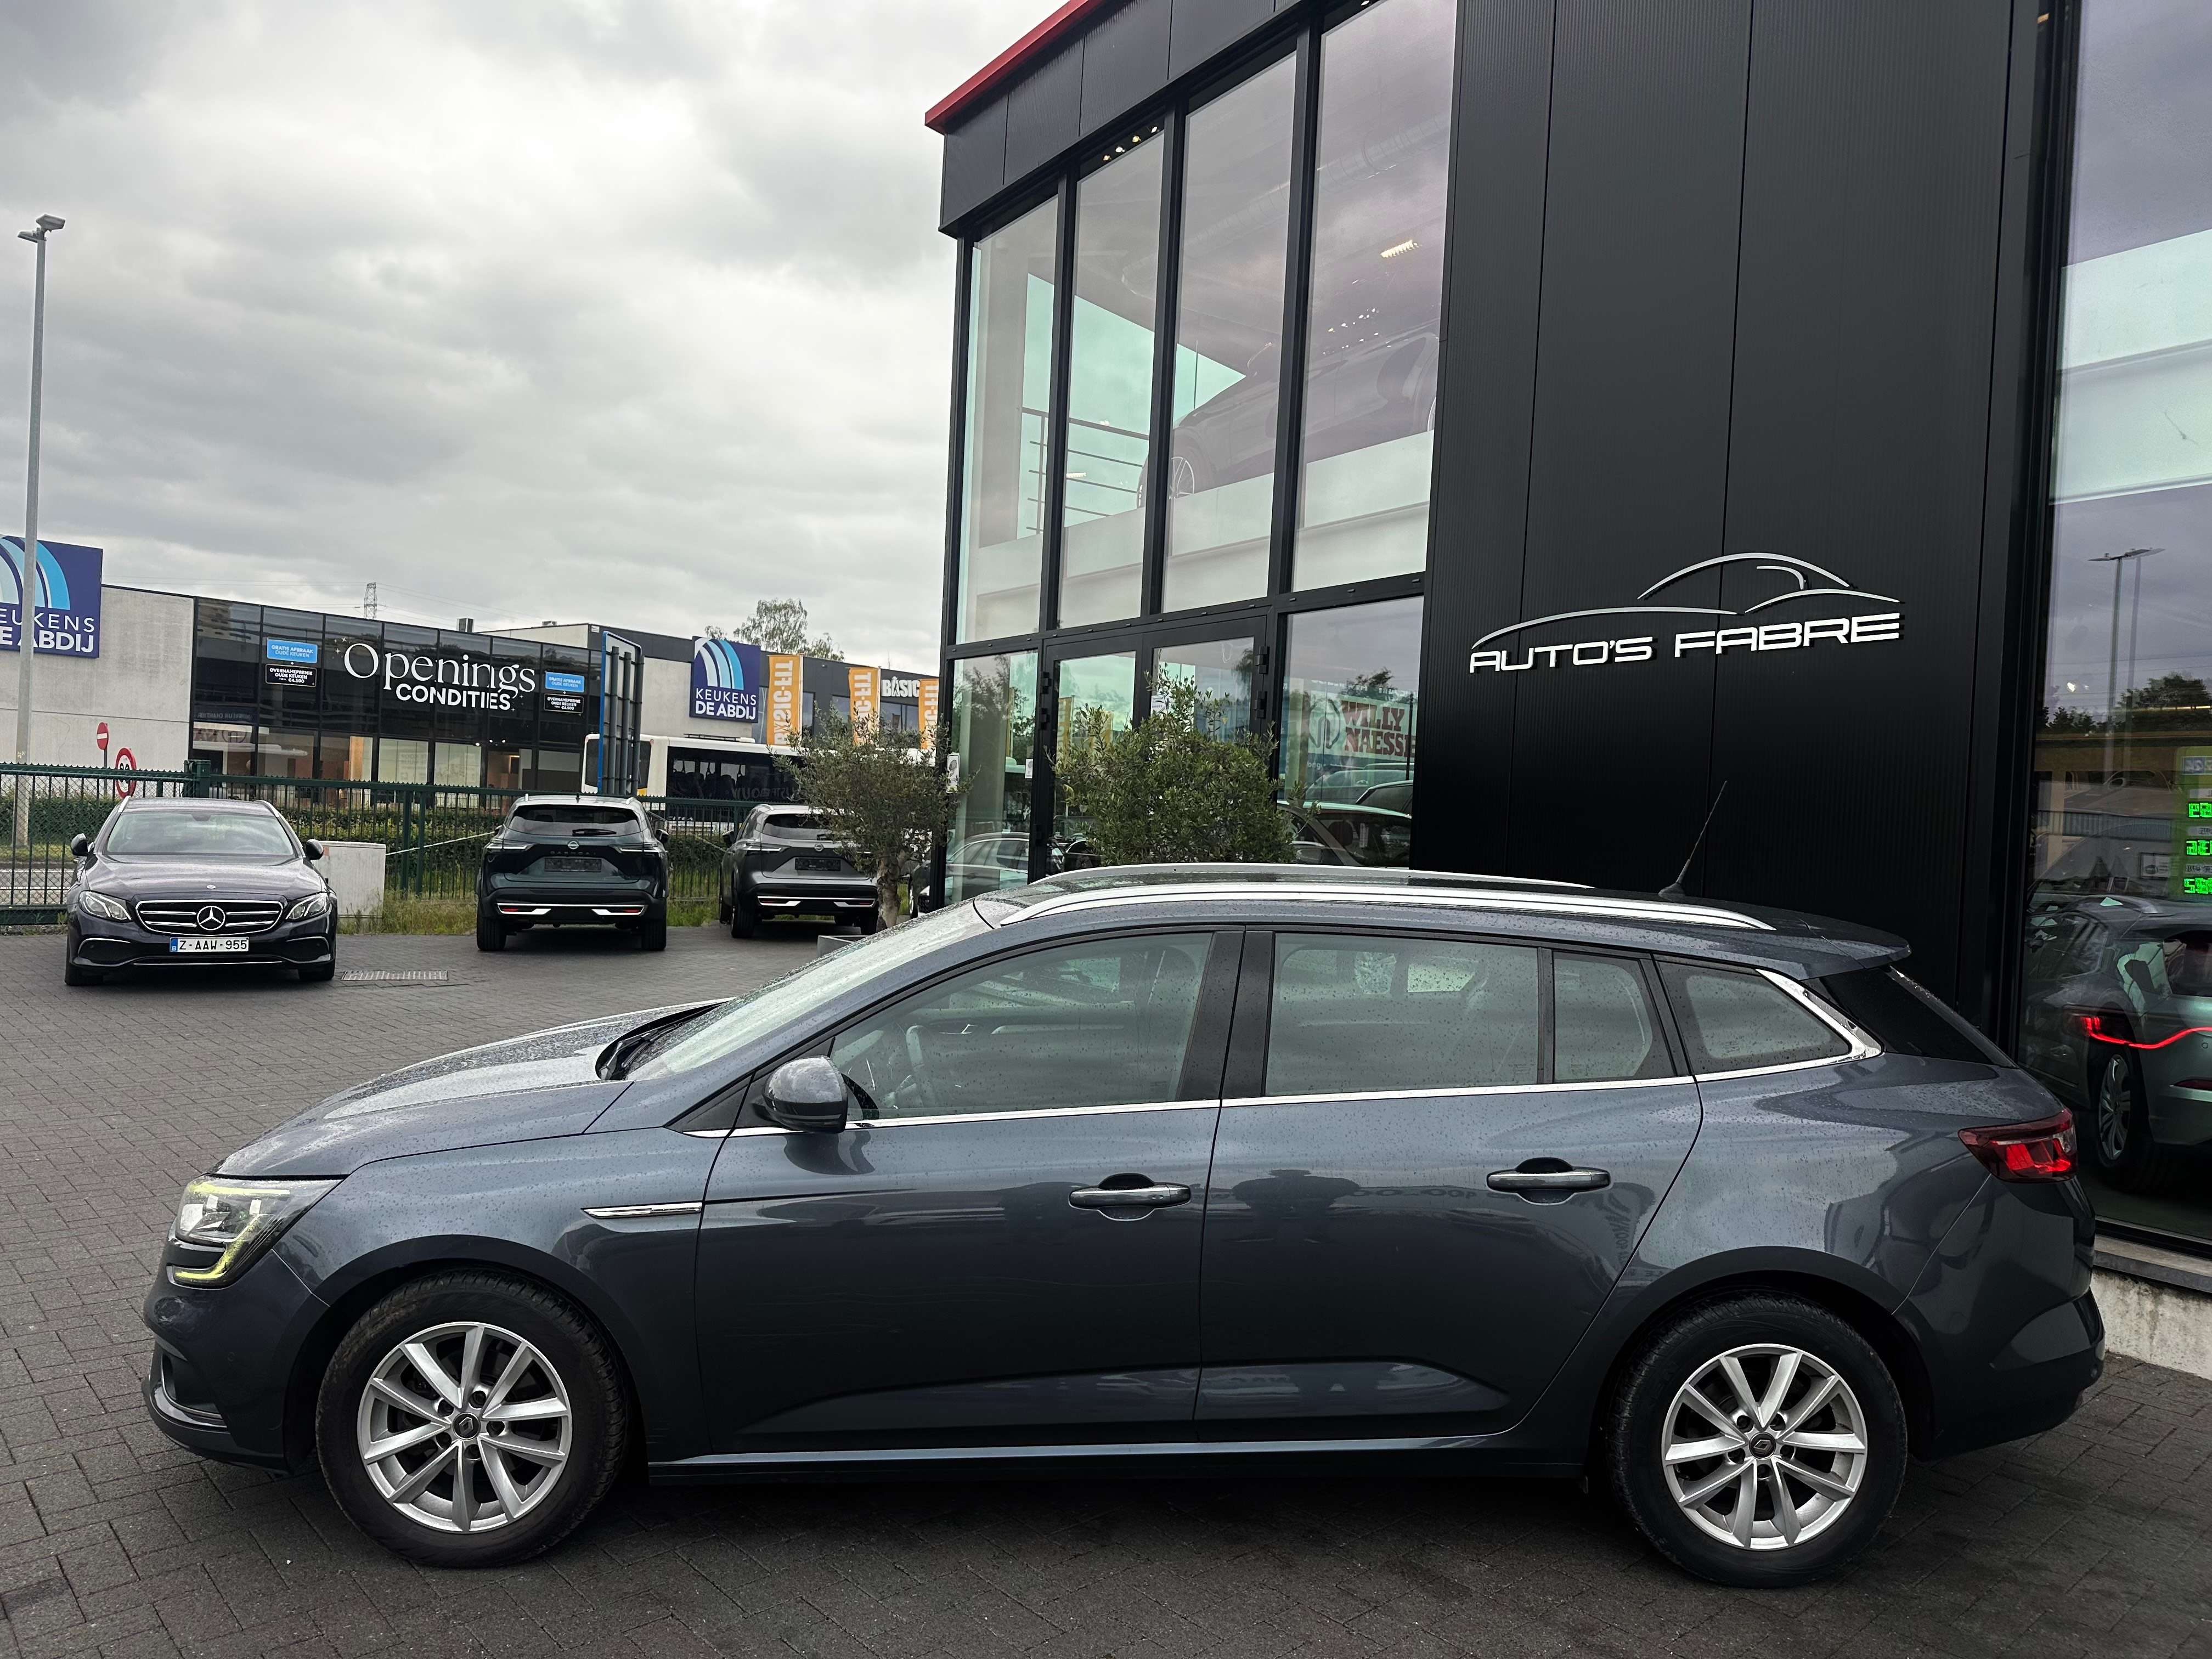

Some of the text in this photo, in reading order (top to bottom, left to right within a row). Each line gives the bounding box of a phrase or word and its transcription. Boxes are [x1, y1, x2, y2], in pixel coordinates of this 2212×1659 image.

[1469, 613, 1900, 674] AUTO'S FABRE
[344, 643, 535, 699] Openings
[396, 683, 511, 711] CONDITIES
[695, 701, 756, 720] DE ABDIJ
[696, 688, 757, 706] KEUKENS
[1341, 700, 1405, 732] WILLY
